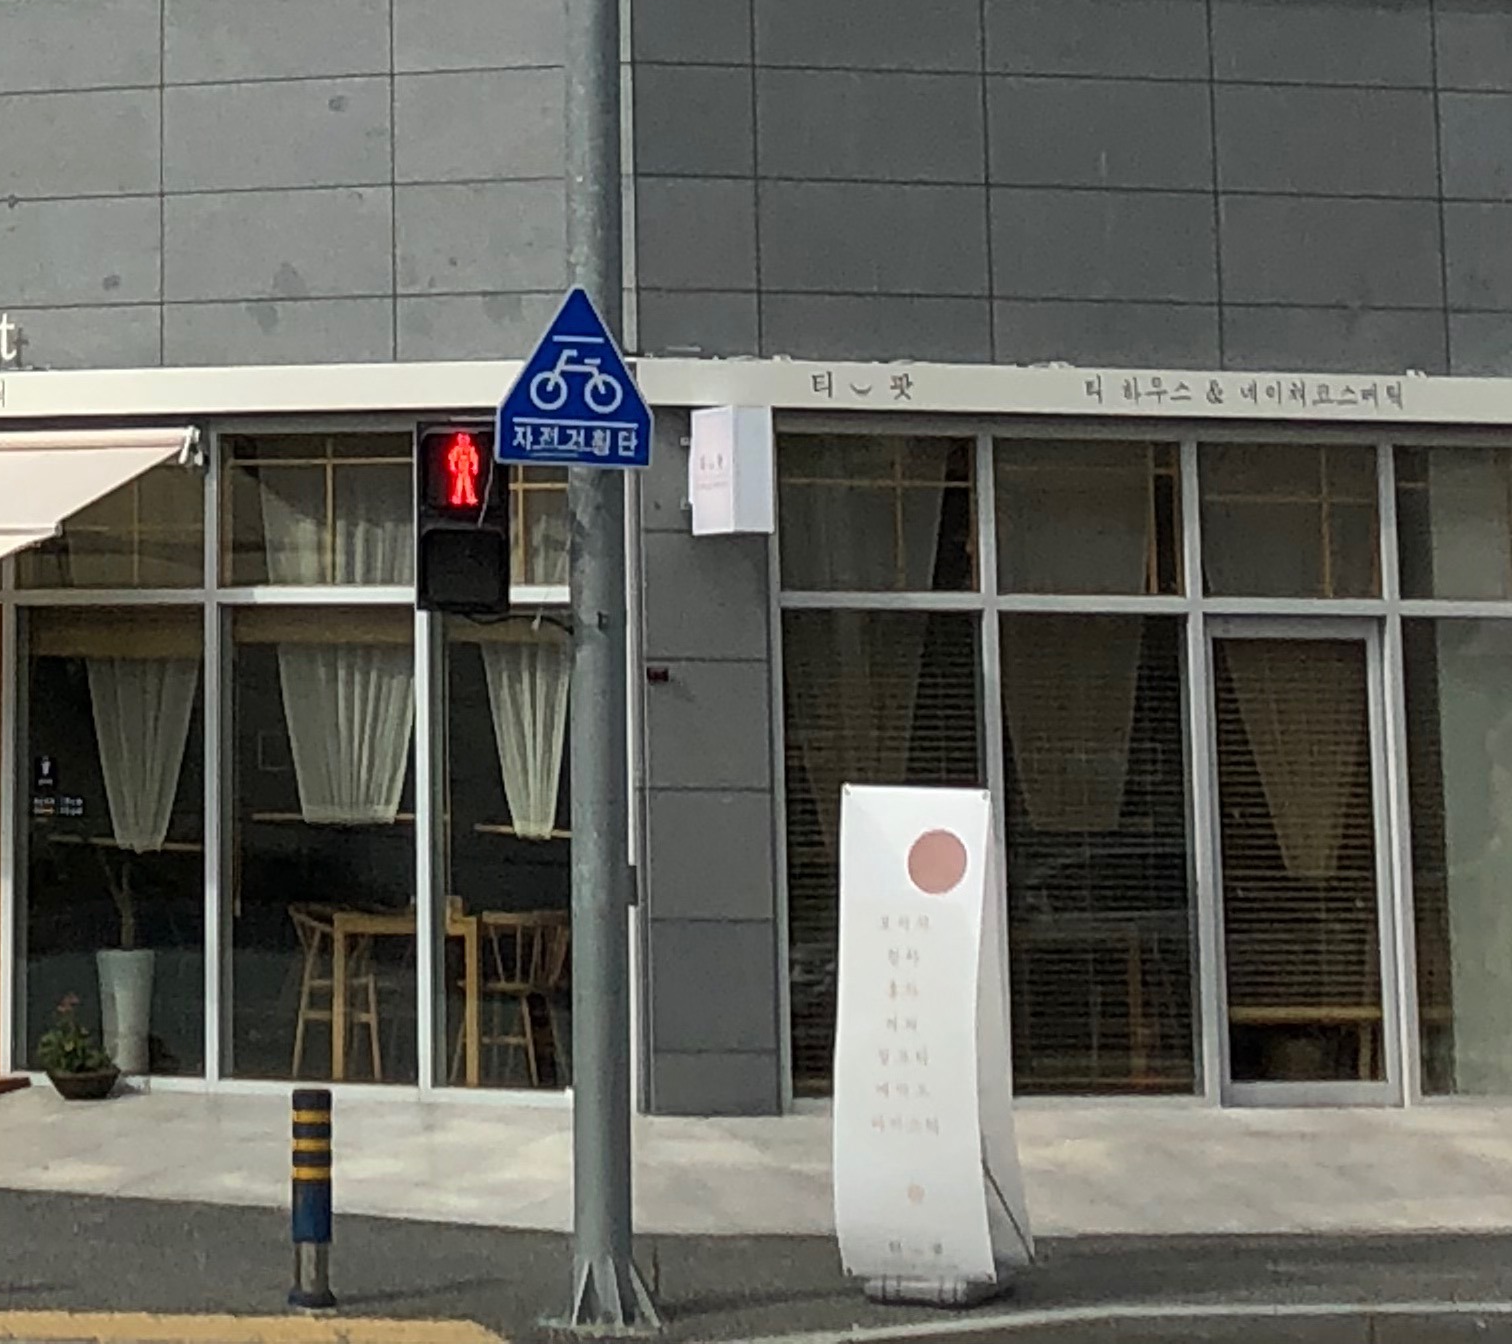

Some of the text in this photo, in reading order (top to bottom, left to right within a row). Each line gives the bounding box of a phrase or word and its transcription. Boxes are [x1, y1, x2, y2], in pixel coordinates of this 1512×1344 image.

[812, 371, 913, 400] 티 팟
[1123, 375, 1192, 404] 하우스
[1205, 379, 1224, 404] &
[512, 425, 638, 456] 자전거횡단
